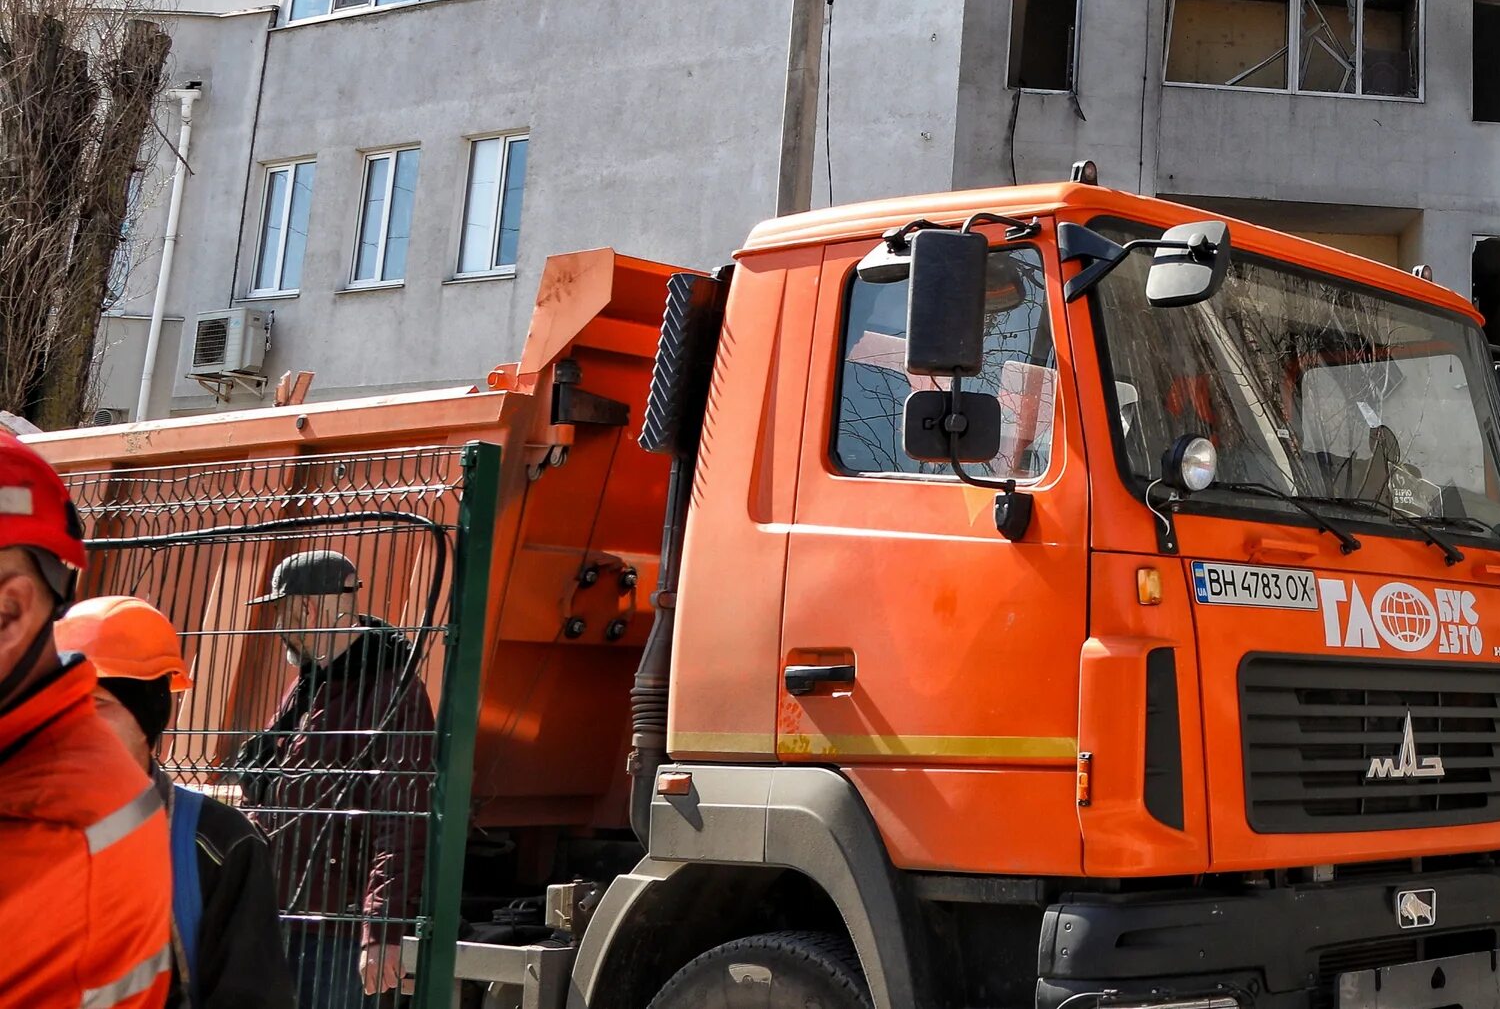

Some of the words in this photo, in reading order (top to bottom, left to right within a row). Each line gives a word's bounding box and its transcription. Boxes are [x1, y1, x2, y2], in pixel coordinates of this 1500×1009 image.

[1197, 587, 1208, 597] UA
[1208, 568, 1237, 597] BH
[1241, 571, 1282, 600] 4783
[1286, 575, 1312, 602] OX
